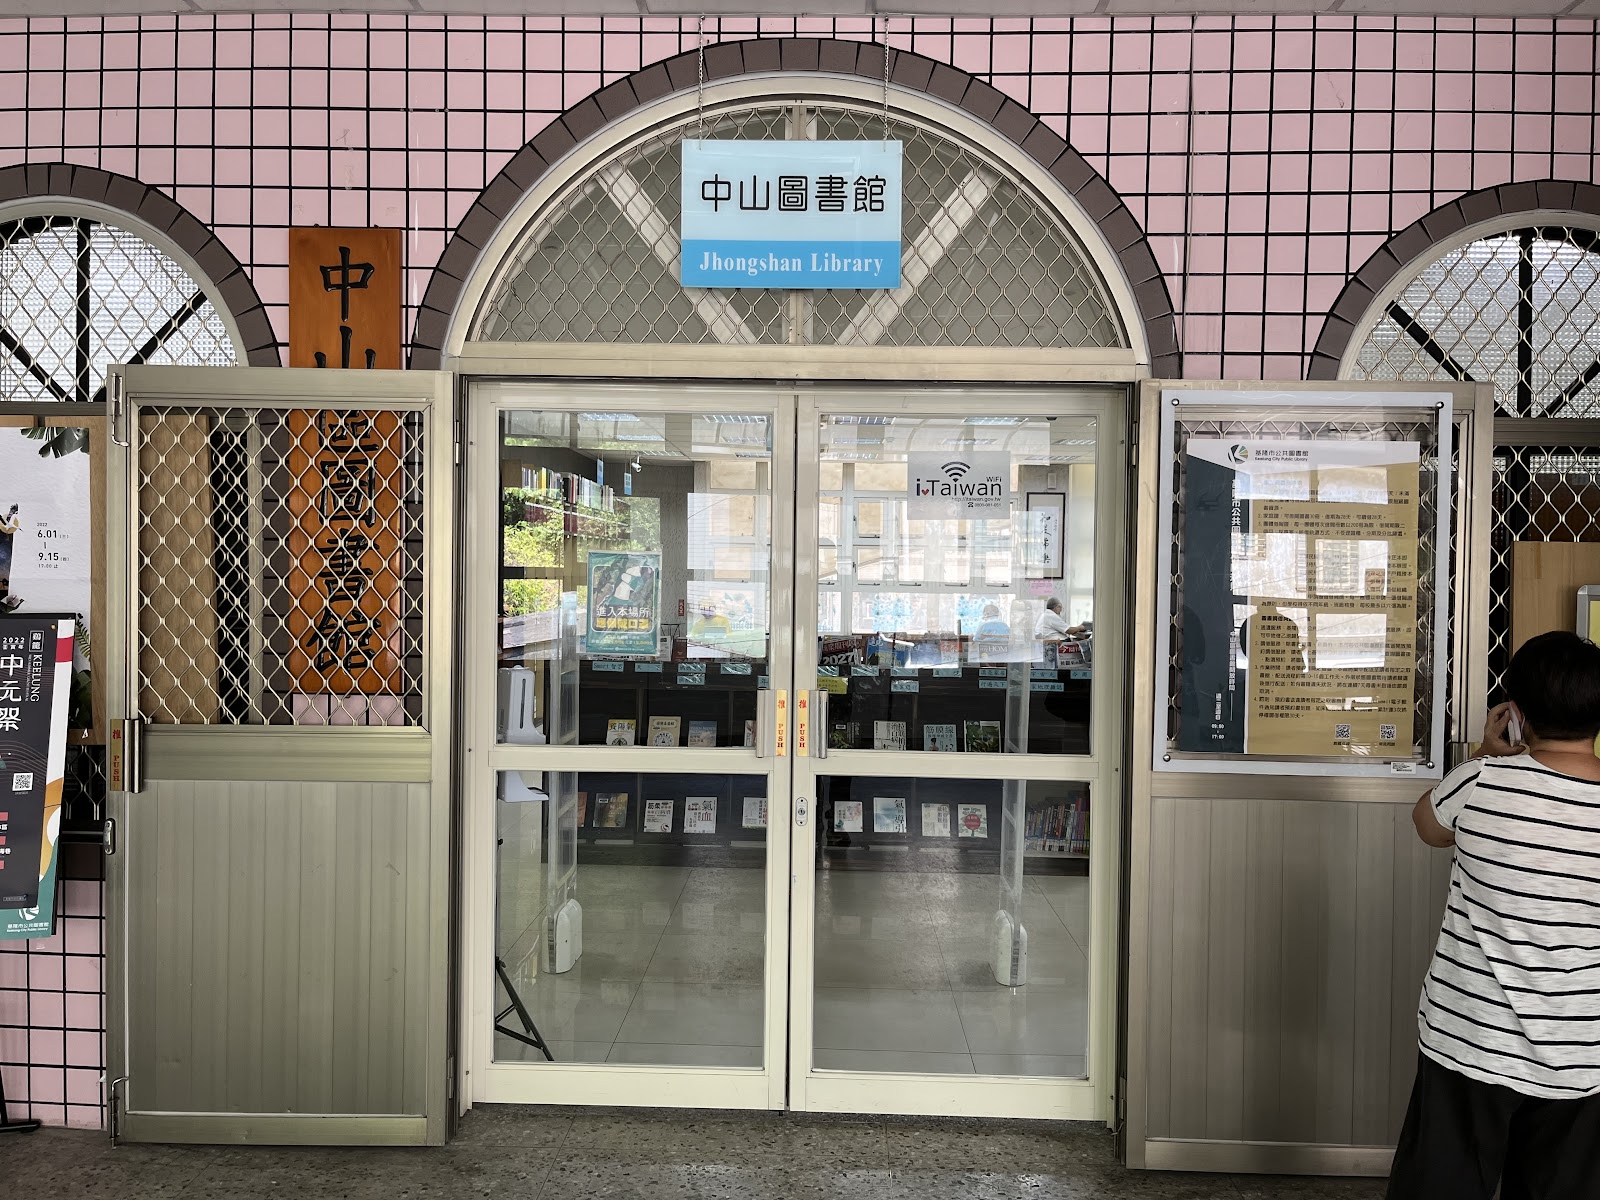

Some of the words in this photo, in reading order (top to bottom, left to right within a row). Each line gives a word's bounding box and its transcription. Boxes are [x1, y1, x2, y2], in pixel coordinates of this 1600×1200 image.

[701, 173, 886, 212] 中山圖書館
[699, 251, 802, 276] Jhongshan
[810, 252, 883, 276] Library
[37, 529, 57, 538] 6.01
[38, 552, 59, 561] 9.15
[596, 607, 650, 618] 進入本場所
[30, 654, 43, 702] KEELUNG
[0, 653, 24, 732] 中元祭
